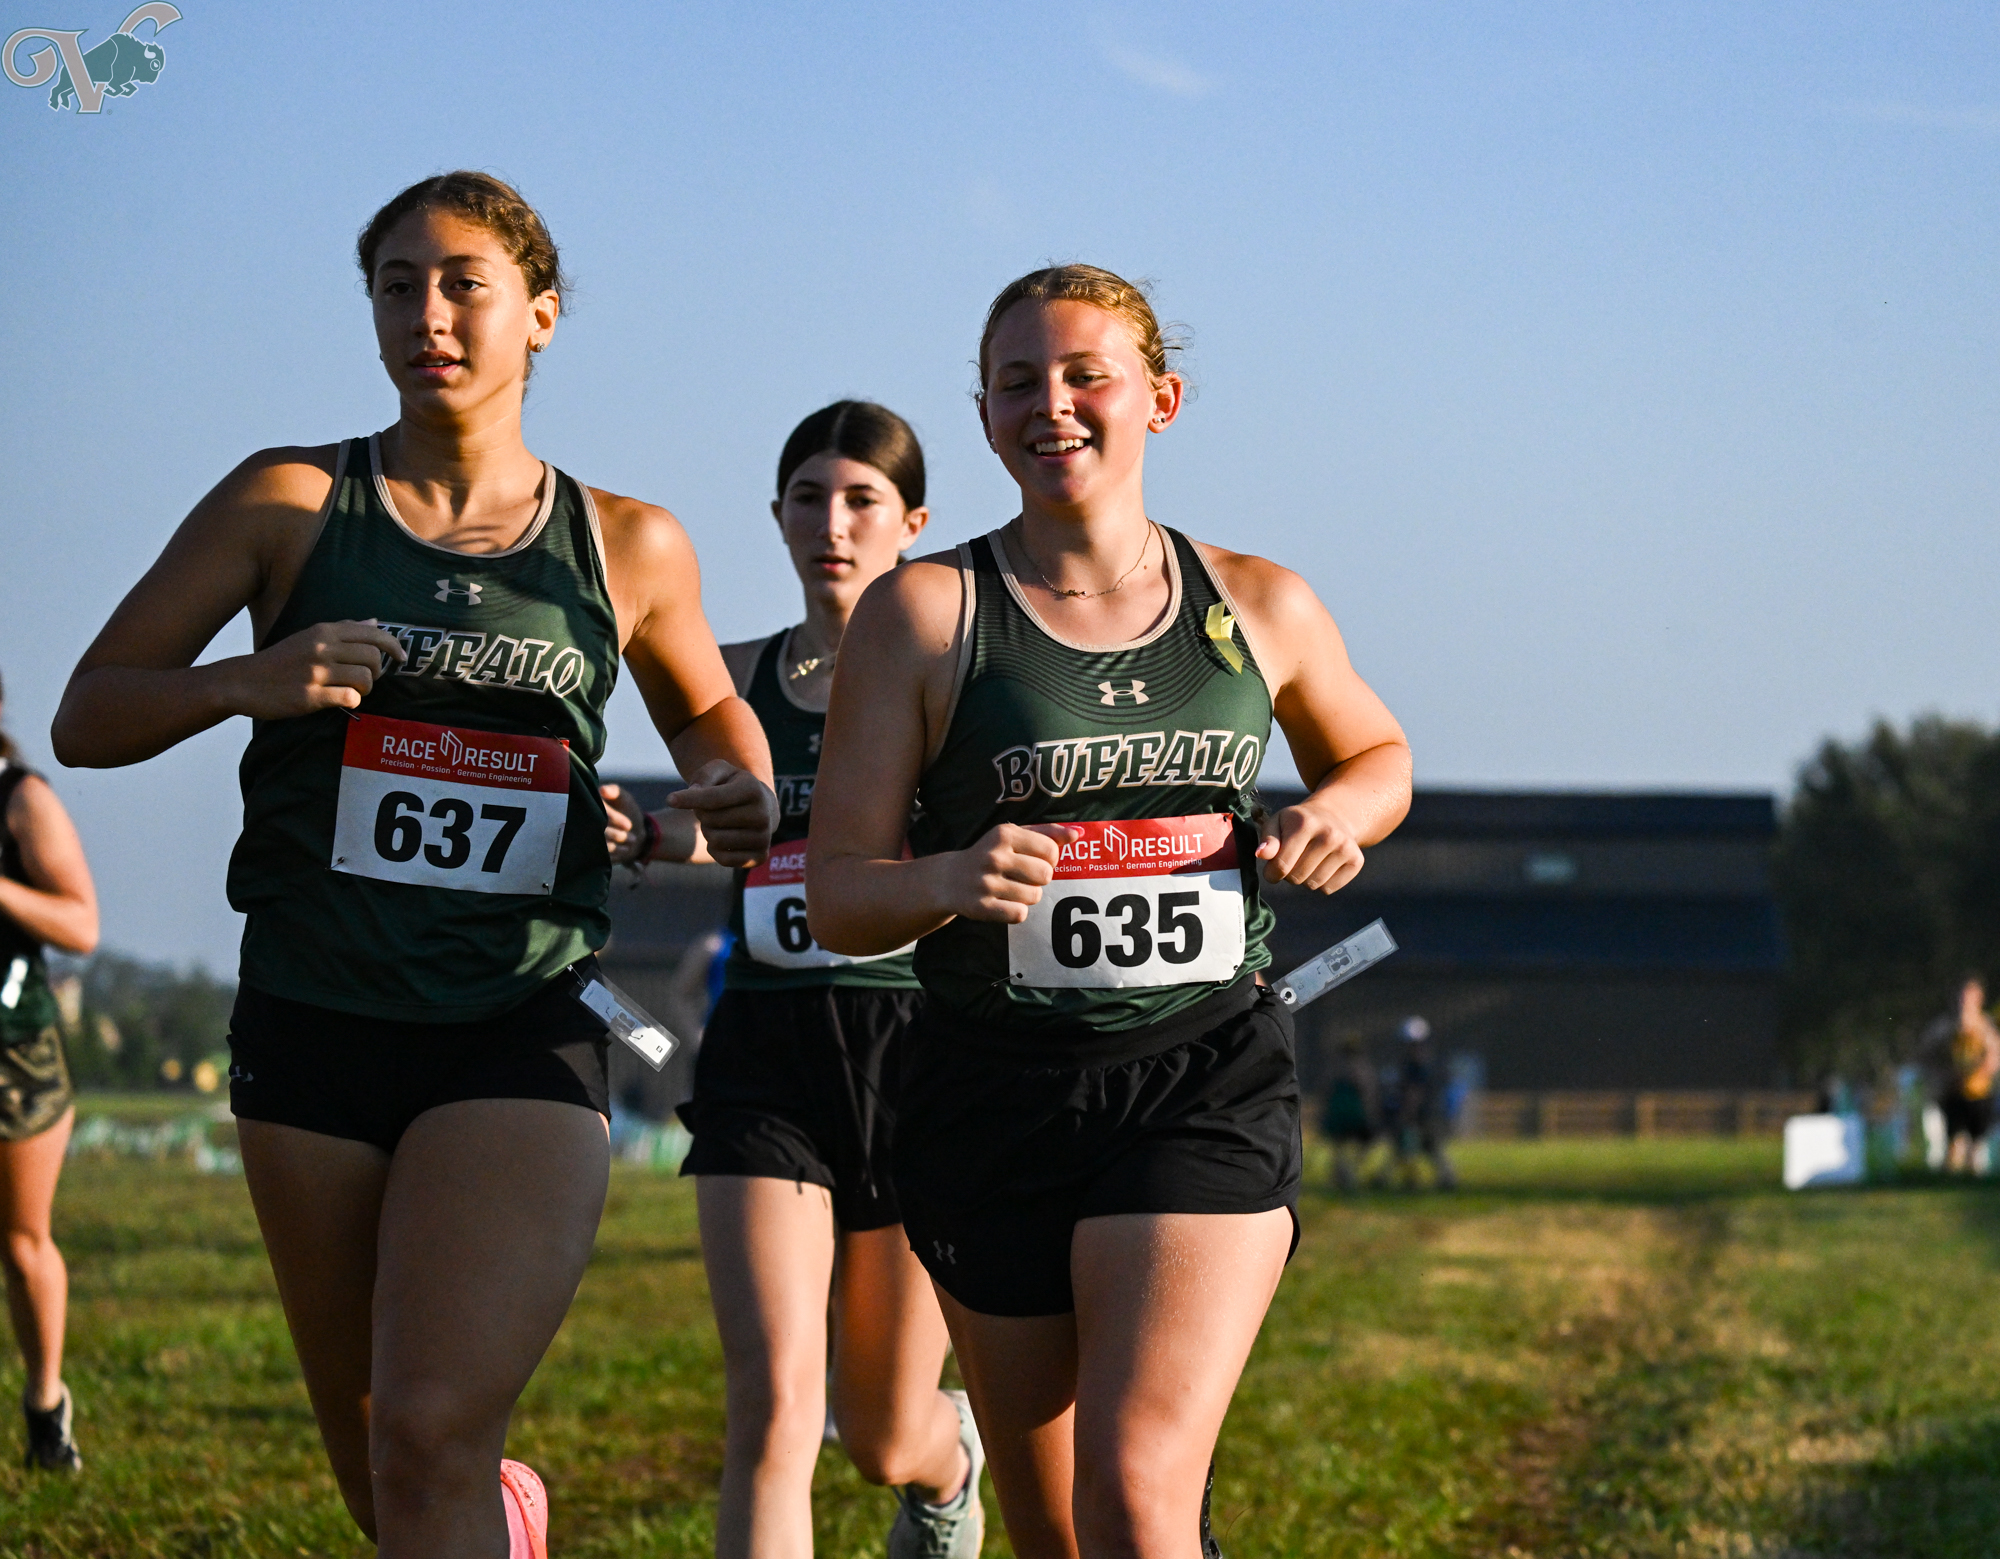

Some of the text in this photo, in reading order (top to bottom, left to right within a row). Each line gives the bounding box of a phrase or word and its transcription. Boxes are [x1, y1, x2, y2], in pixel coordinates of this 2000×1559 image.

[380, 757, 532, 785] Precision Passion German Engineering
[382, 735, 539, 773] RACE RESULT
[991, 729, 1260, 804] BUFFALO
[374, 791, 527, 874] 637
[1060, 834, 1204, 861] ACE RESULT
[1054, 858, 1203, 873] ecision Passion German Engineering
[1050, 891, 1204, 969] 635
